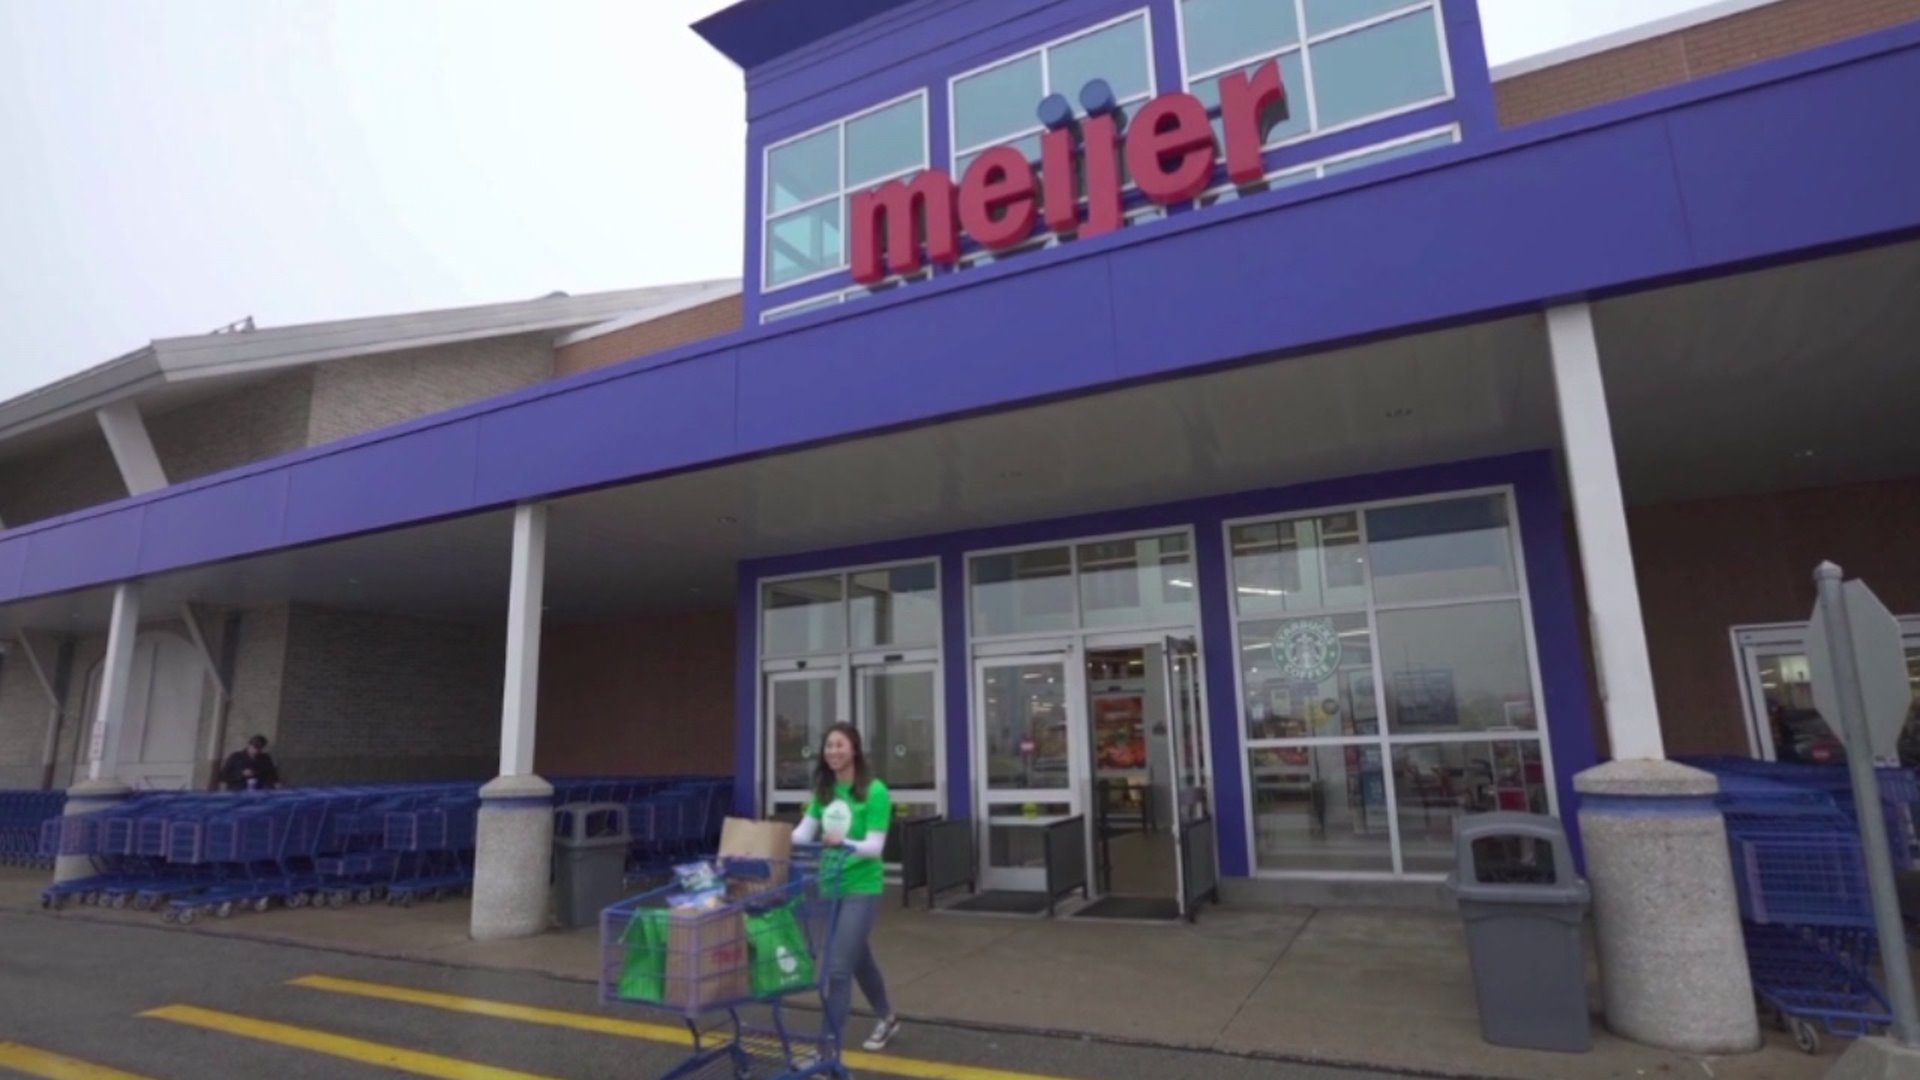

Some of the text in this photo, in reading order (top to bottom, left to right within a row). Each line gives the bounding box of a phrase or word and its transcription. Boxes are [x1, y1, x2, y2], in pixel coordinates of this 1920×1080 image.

[850, 58, 1289, 283] meijer
[1275, 621, 1336, 648] STARBUCKS
[1283, 663, 1329, 679] COFFEE
